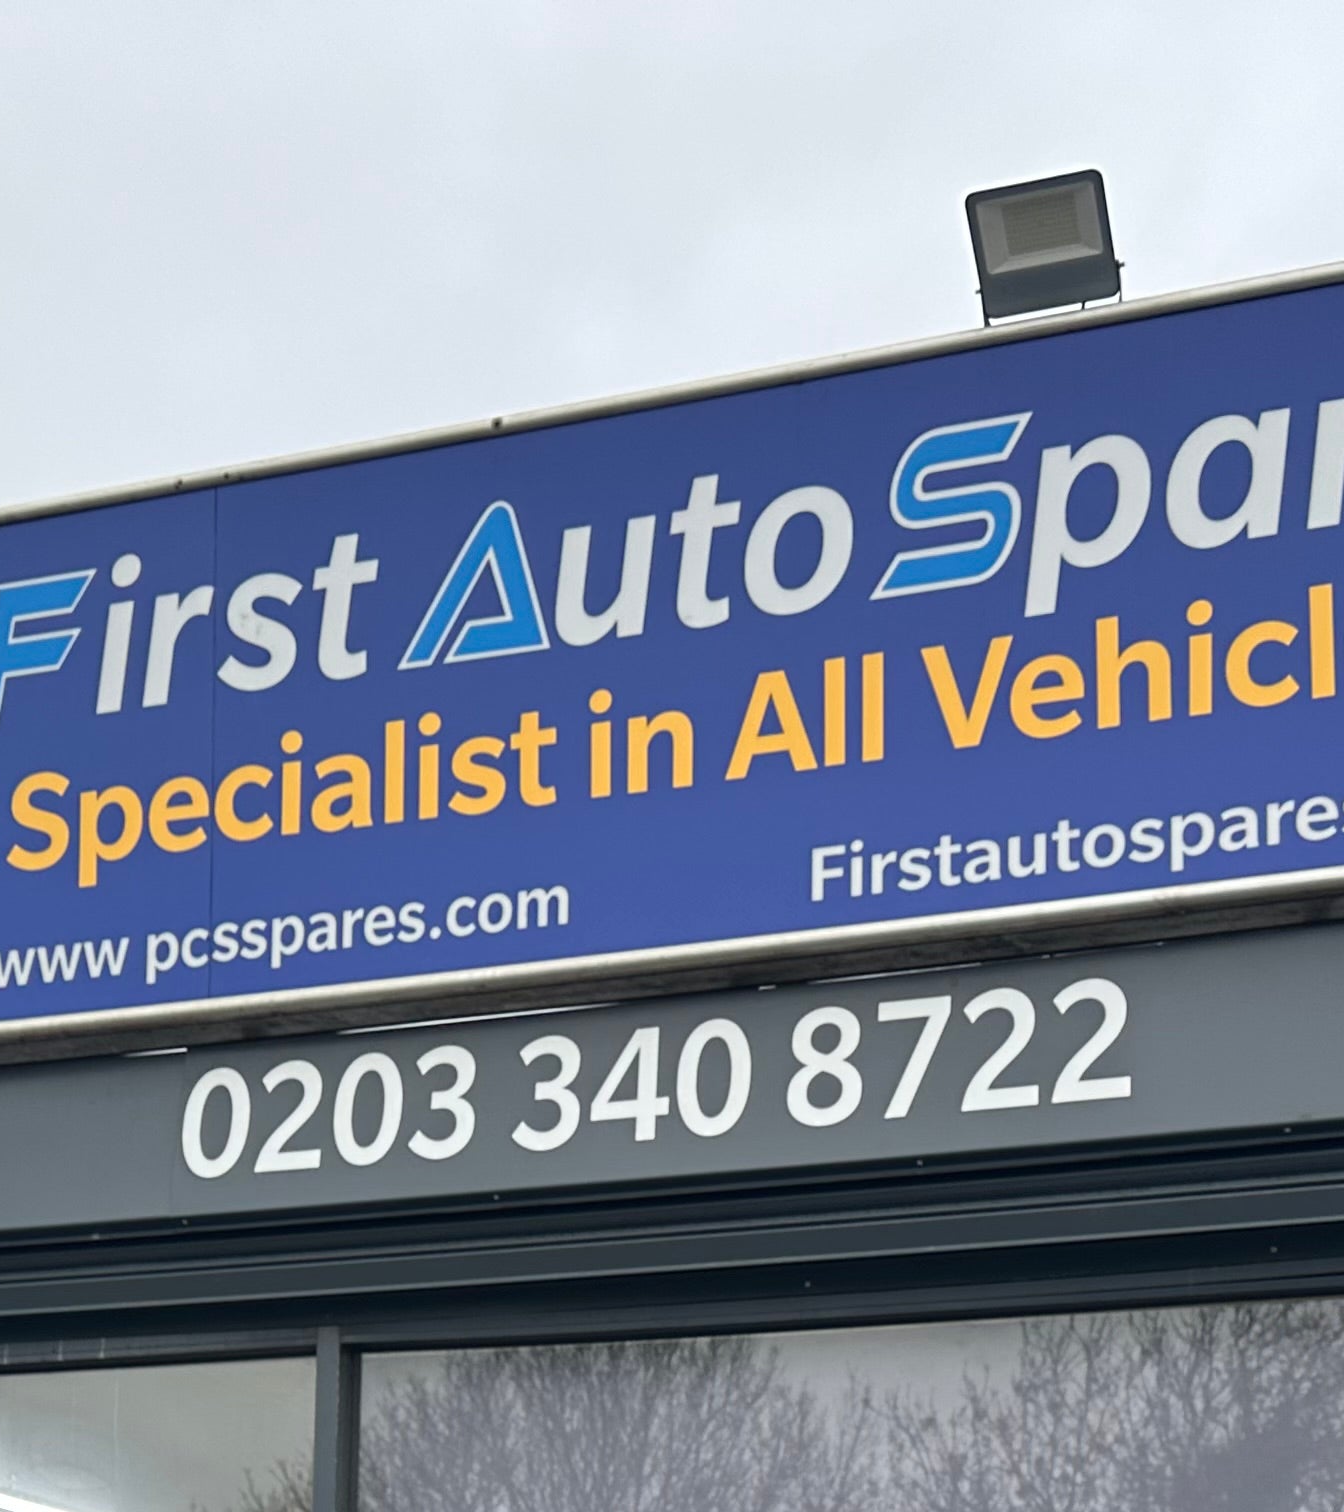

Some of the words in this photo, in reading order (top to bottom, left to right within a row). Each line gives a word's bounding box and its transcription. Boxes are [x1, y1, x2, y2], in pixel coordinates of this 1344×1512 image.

[397, 470, 853, 670] Auto
[7, 710, 556, 888] Specialist
[588, 689, 694, 800] in
[725, 652, 884, 781] All
[145, 884, 571, 984] pcsspares.com
[182, 1044, 477, 1178] 0203
[512, 1026, 753, 1151] 340
[786, 978, 1133, 1128] 8722
